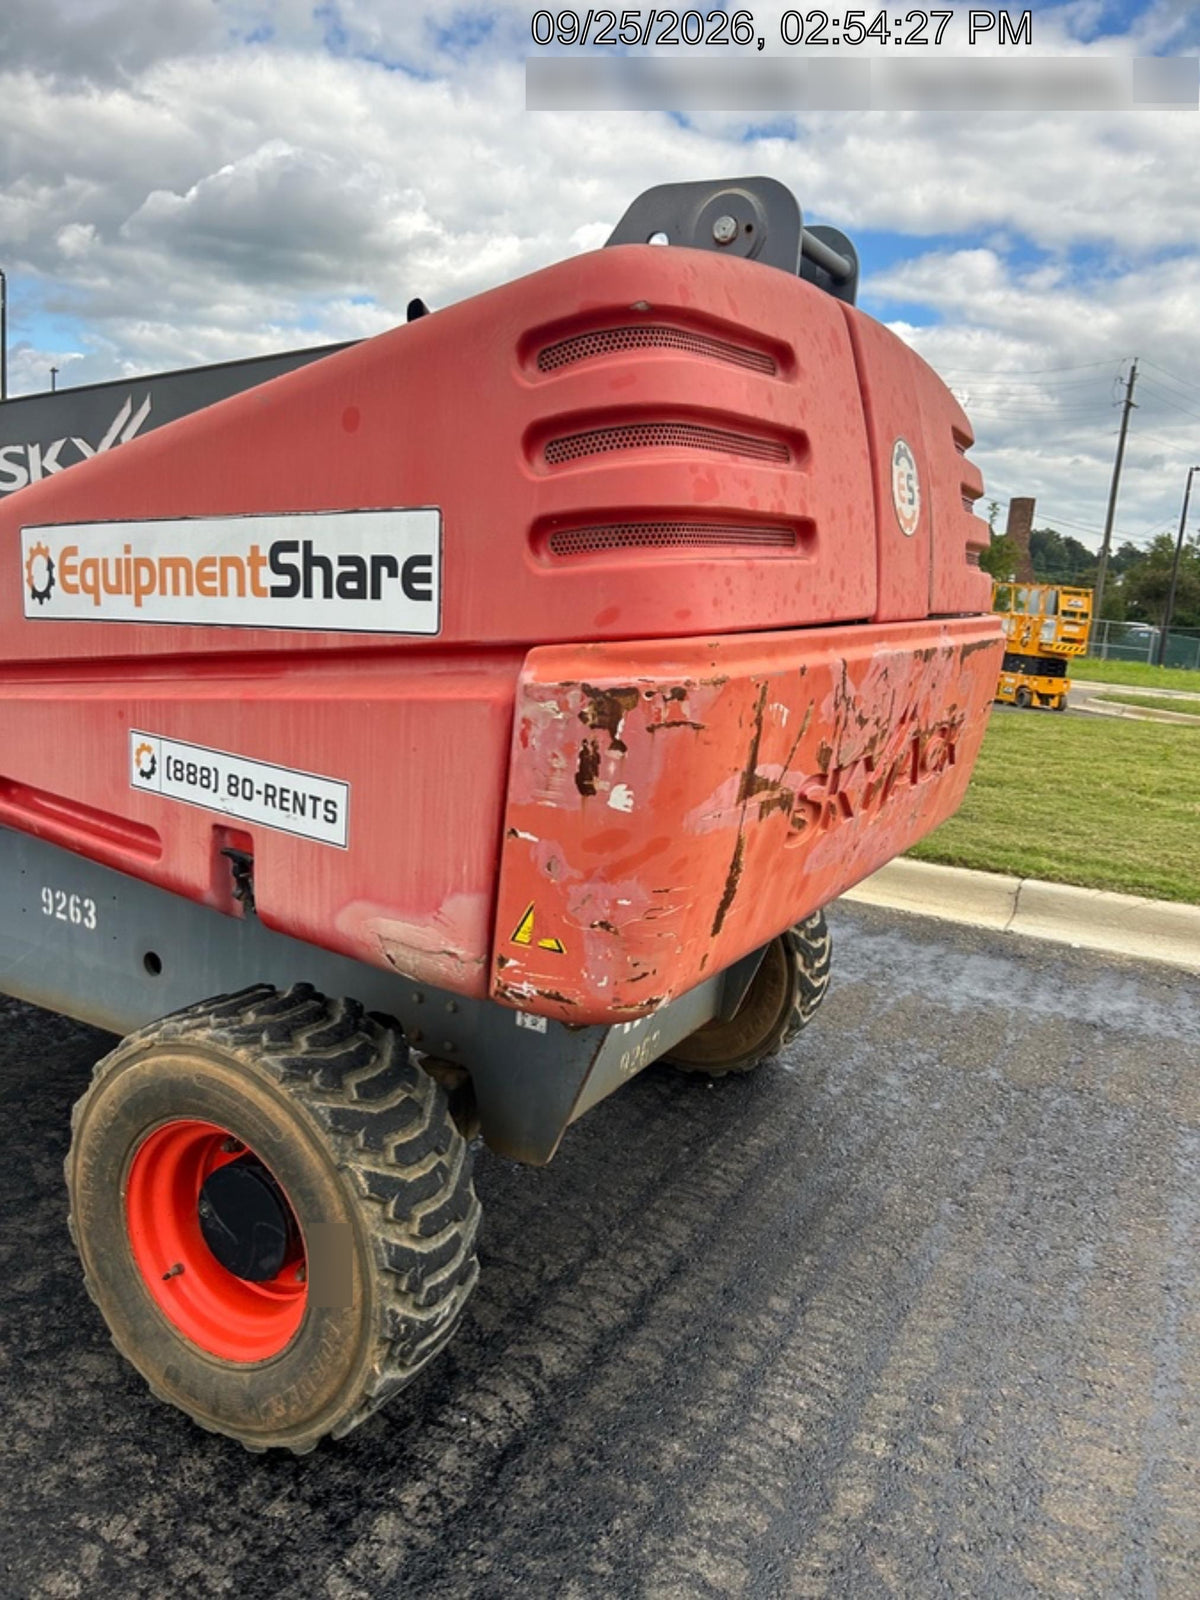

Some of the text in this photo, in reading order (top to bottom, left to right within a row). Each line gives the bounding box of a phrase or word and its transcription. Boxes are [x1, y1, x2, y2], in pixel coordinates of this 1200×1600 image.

[59, 540, 432, 607] EquipmentShare
[166, 755, 338, 824] (888) 80-RENTS
[41, 886, 97, 930] 9263
